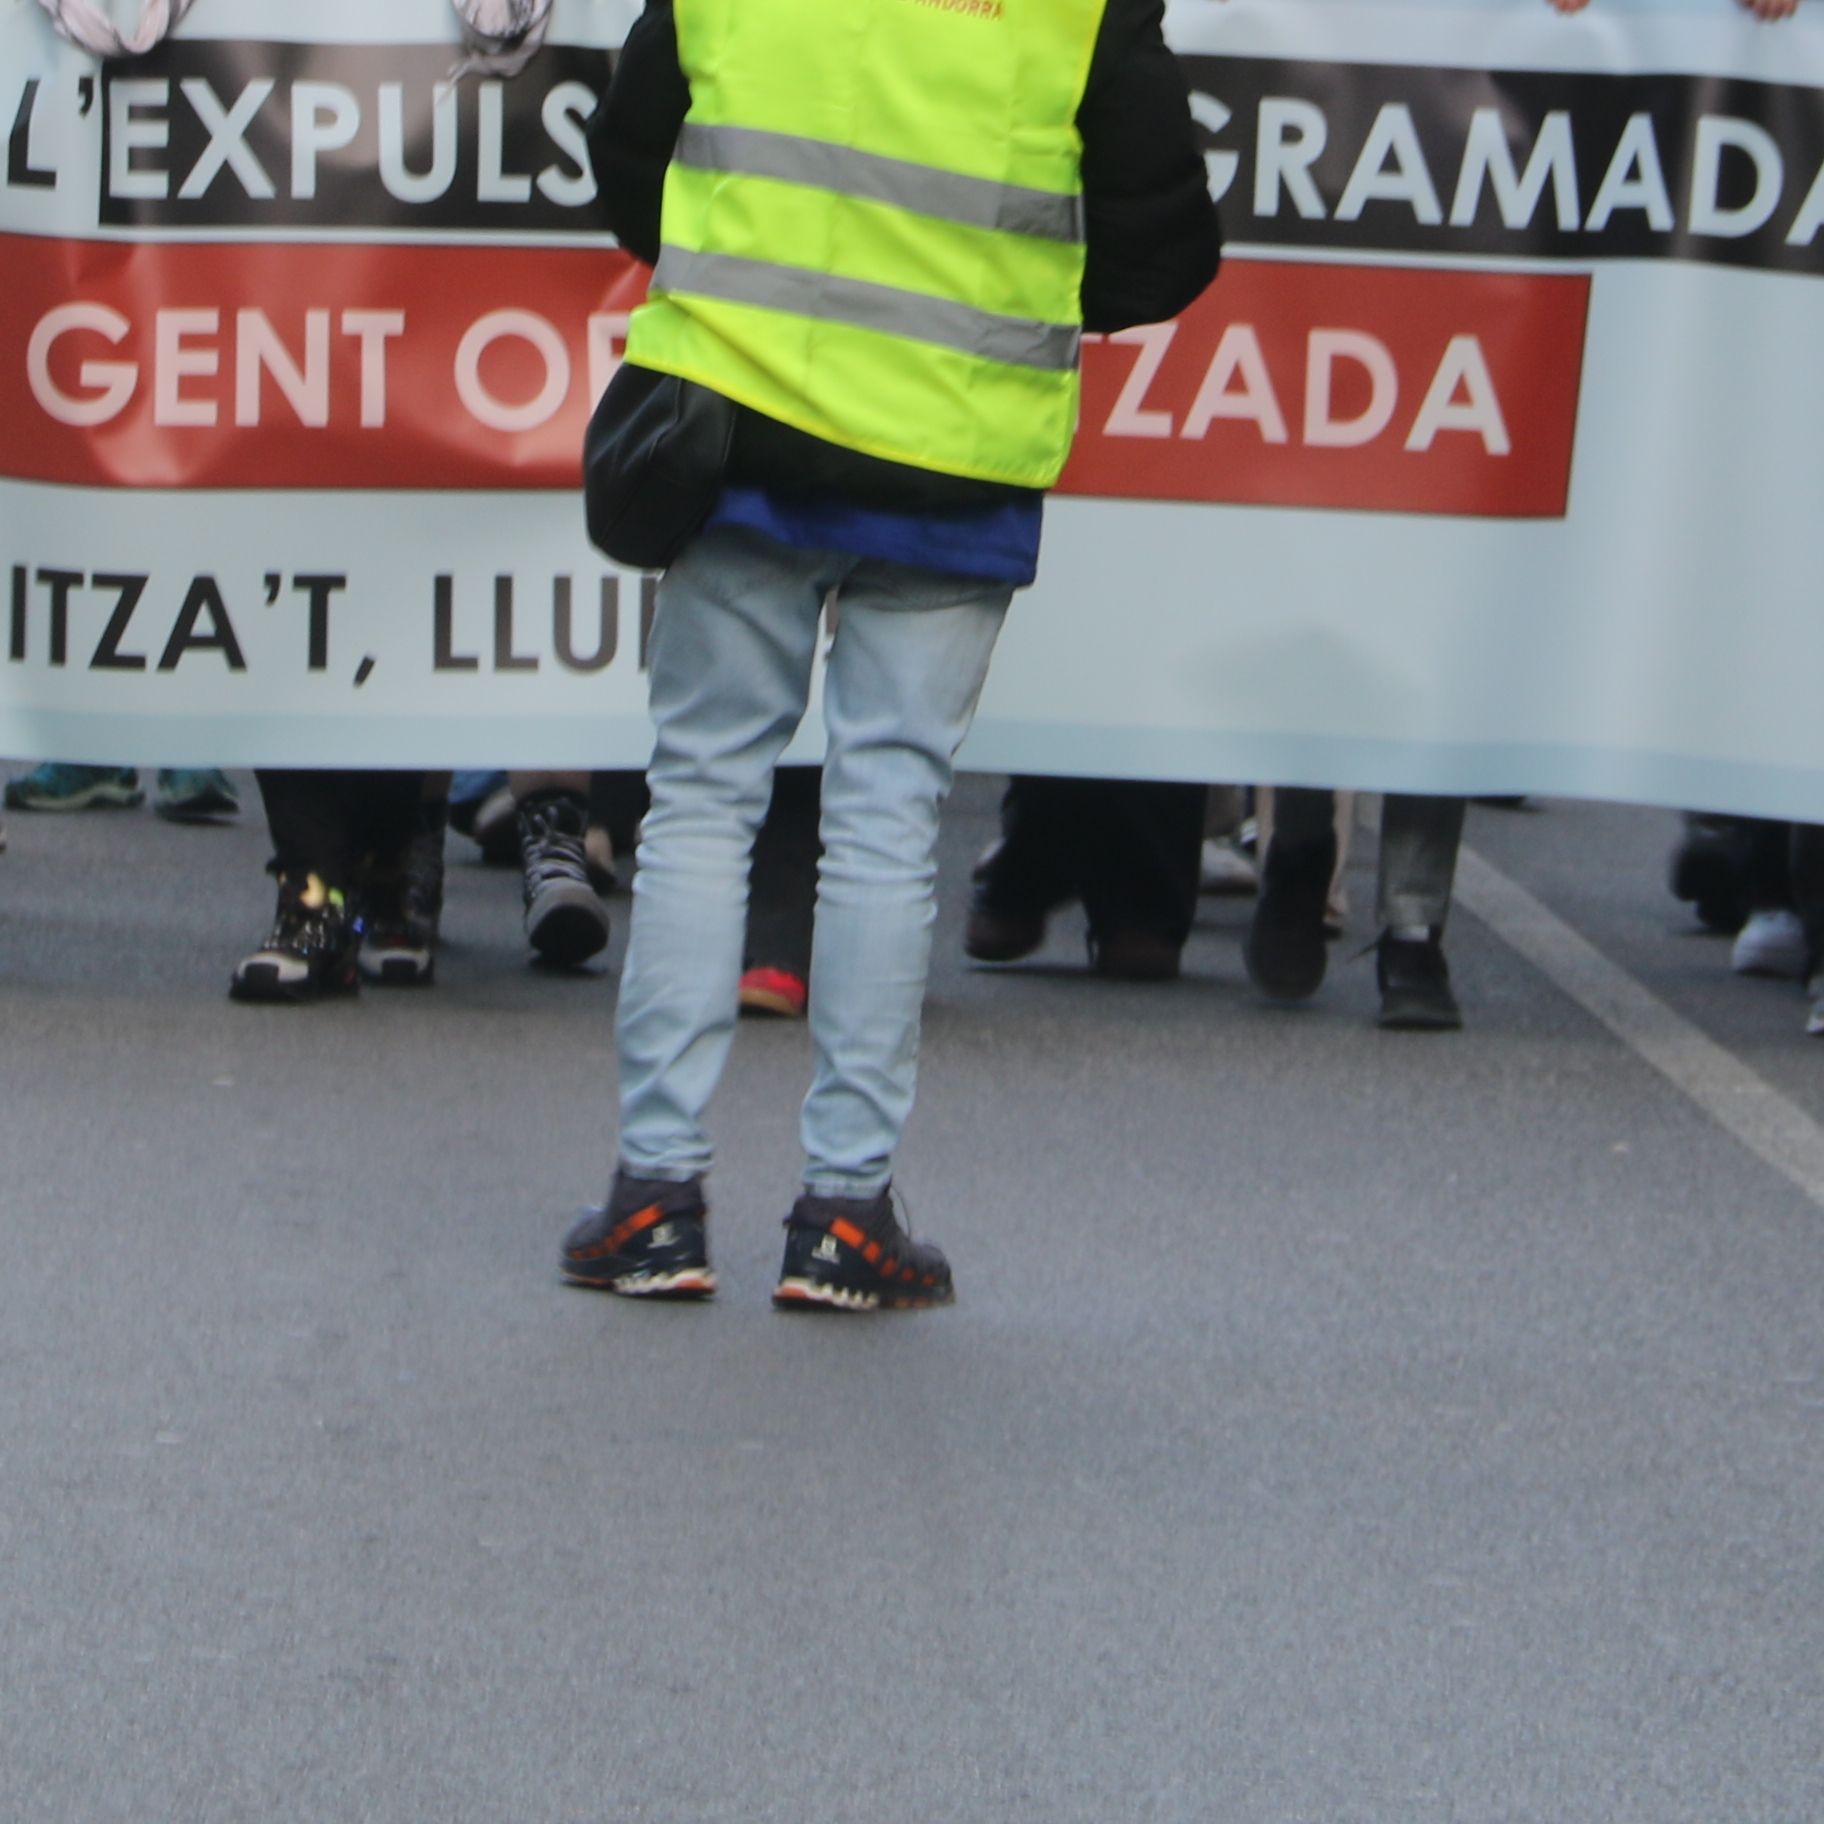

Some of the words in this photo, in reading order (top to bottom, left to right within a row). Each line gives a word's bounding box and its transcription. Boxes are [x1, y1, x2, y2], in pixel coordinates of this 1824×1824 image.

[26, 300, 405, 429] GENT
[1079, 321, 1513, 457] ZADA
[431, 572, 657, 674] LLU
